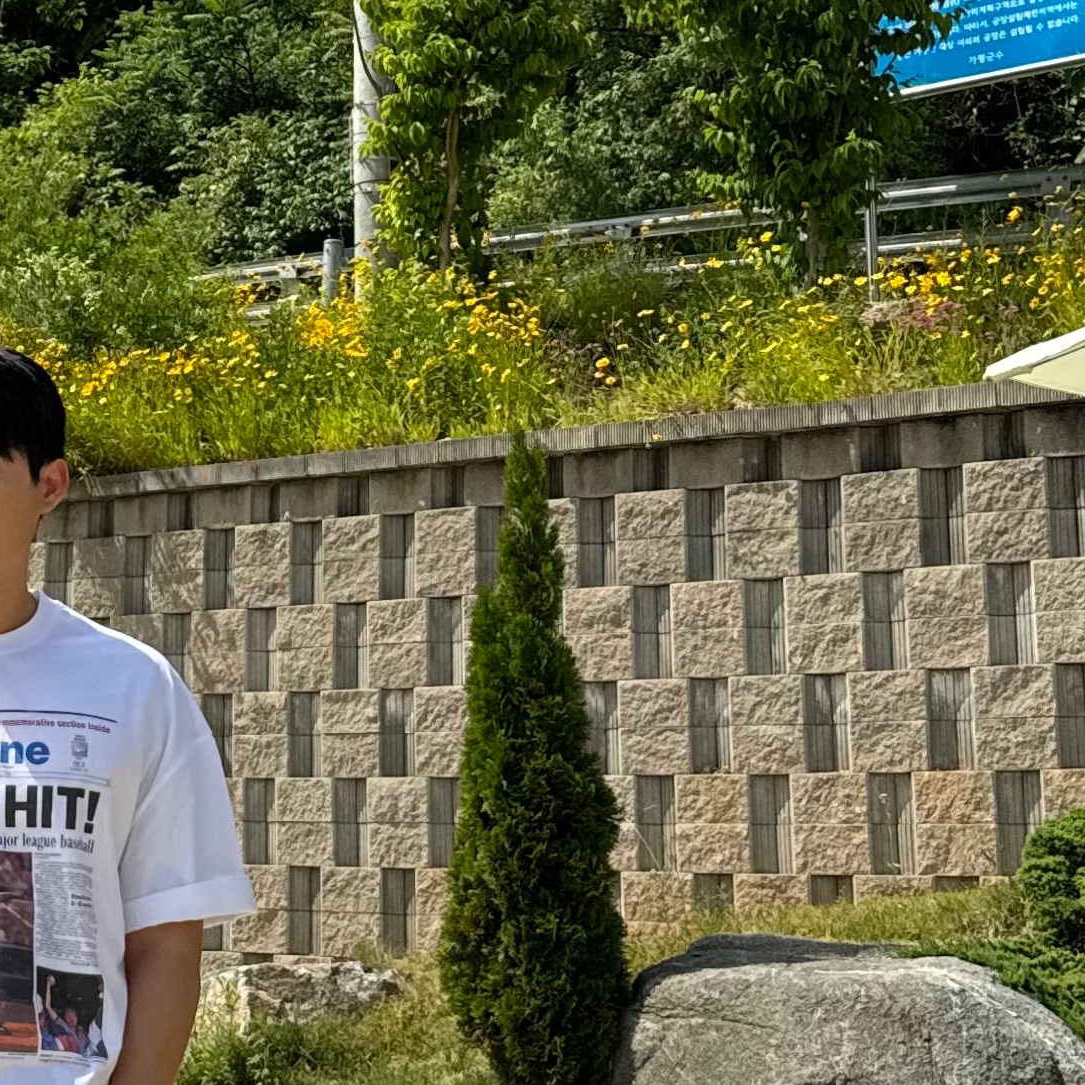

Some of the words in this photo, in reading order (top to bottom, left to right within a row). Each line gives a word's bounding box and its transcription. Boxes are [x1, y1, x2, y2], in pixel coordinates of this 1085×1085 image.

[1035, 22, 1044, 31] 수
[968, 50, 1005, 65] 가평군수
[4, 784, 101, 834] HIT!
[22, 832, 57, 851] league
